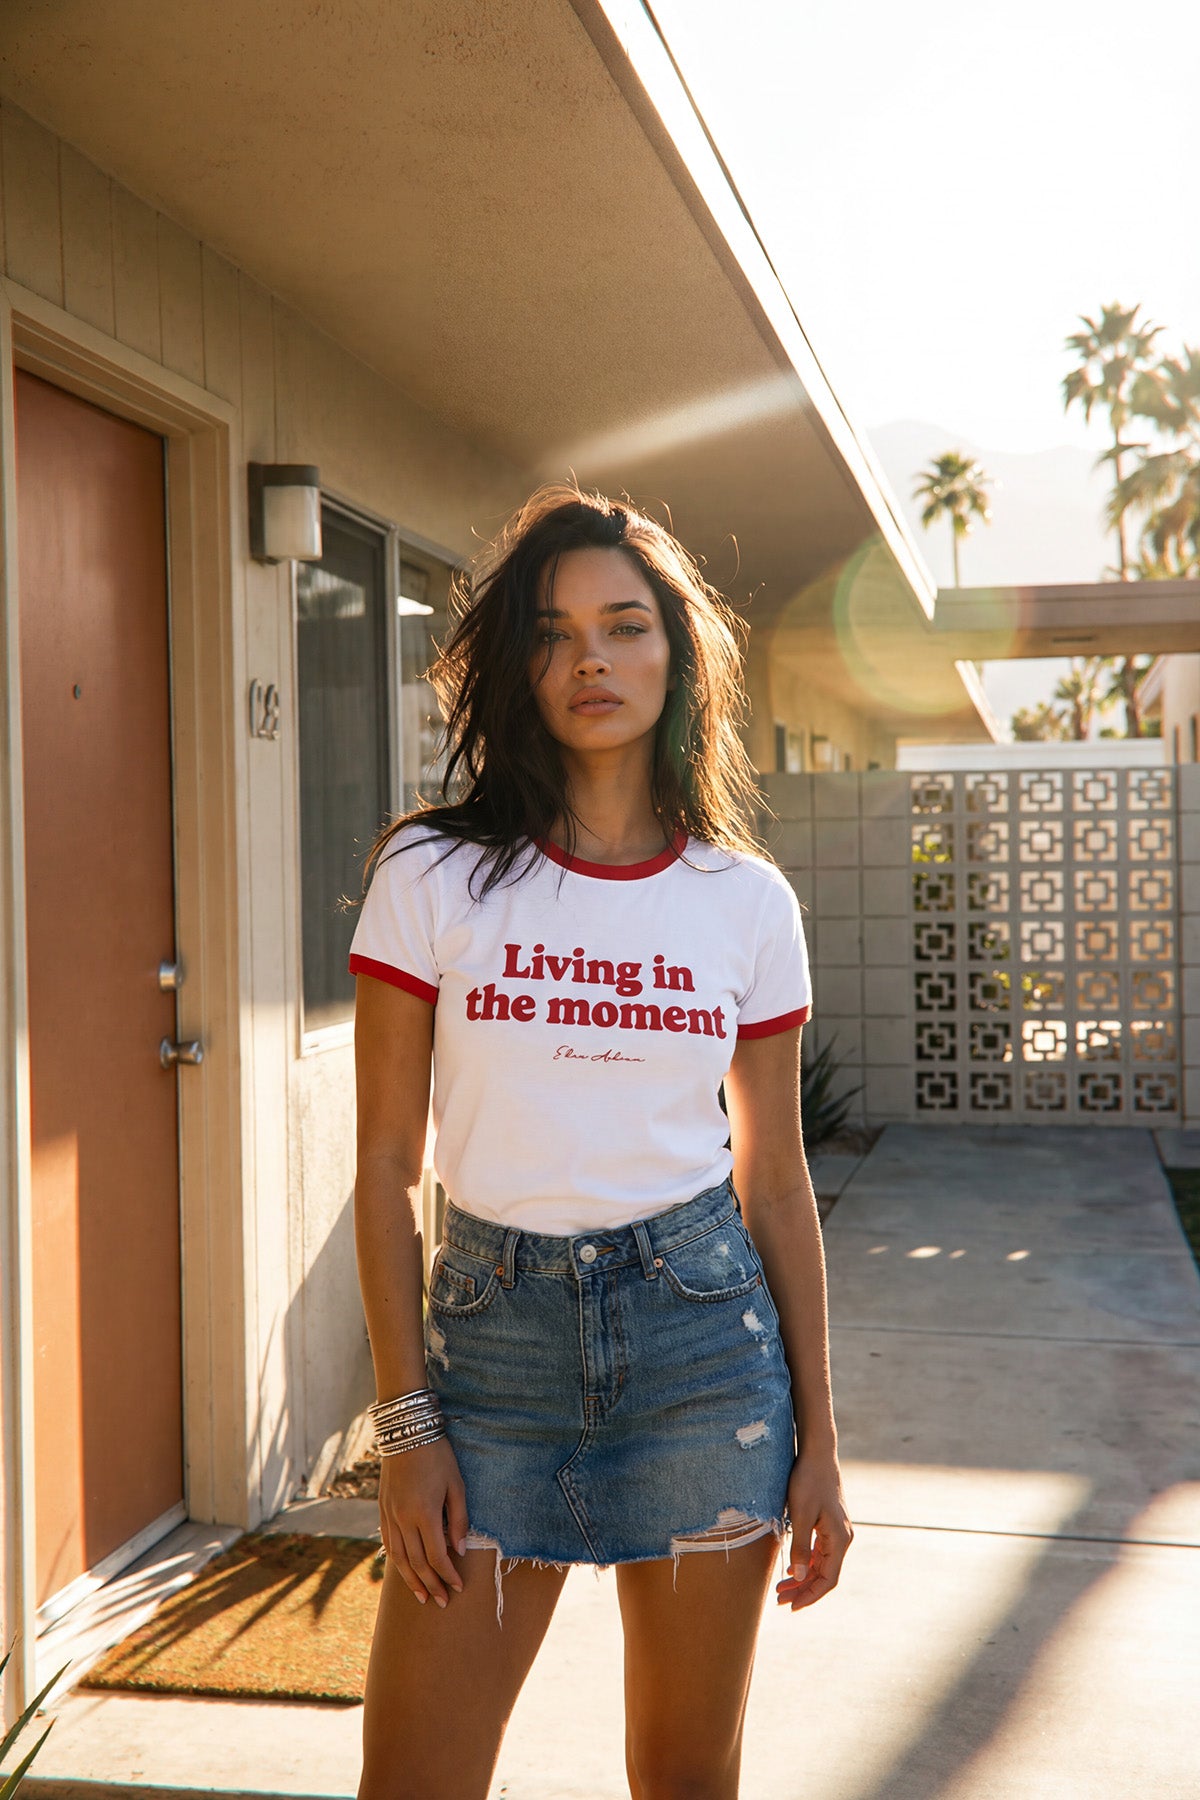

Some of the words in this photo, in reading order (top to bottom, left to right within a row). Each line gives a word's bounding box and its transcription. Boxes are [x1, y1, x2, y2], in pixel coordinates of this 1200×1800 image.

[503, 944, 643, 997] Living
[653, 955, 695, 992] in
[466, 984, 536, 1022] the
[546, 998, 727, 1039] moment
